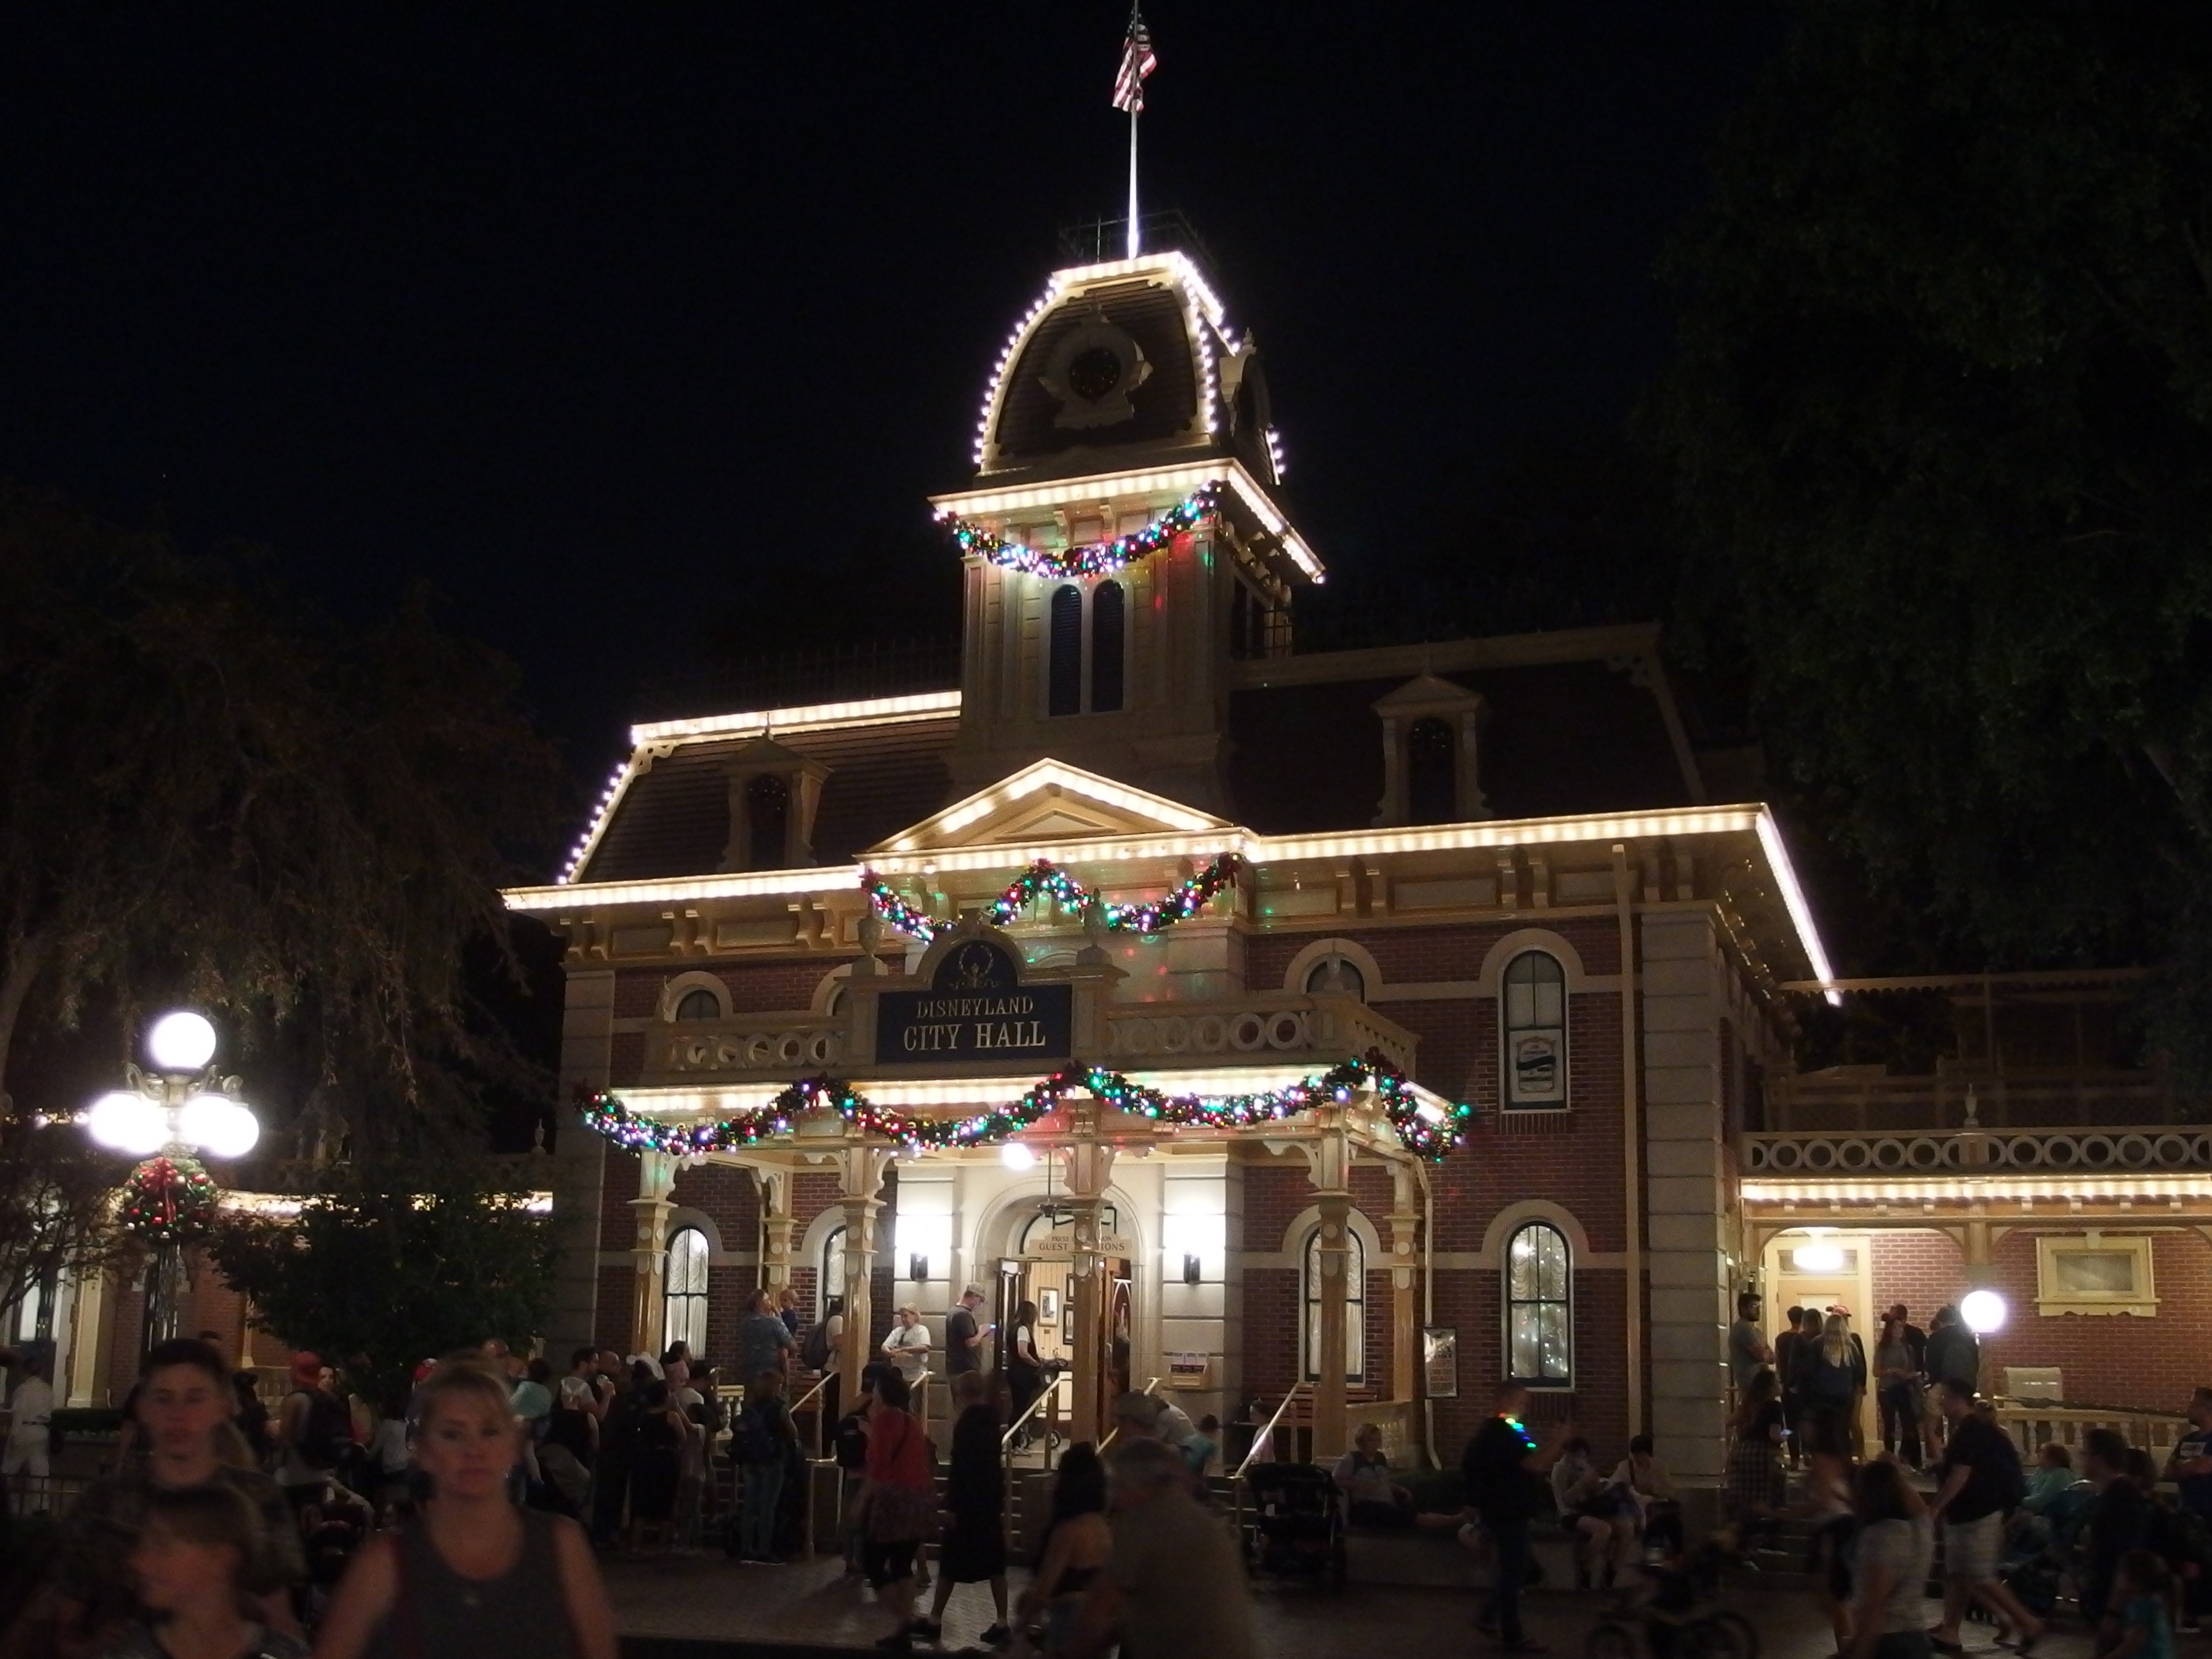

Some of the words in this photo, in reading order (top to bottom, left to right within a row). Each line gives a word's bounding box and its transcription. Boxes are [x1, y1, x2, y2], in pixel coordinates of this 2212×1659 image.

[916, 996, 1034, 1018] DISNEYLAND
[903, 1024, 962, 1051] CITY
[975, 1021, 1046, 1049] HALL
[1039, 1243, 1068, 1251] GUEST
